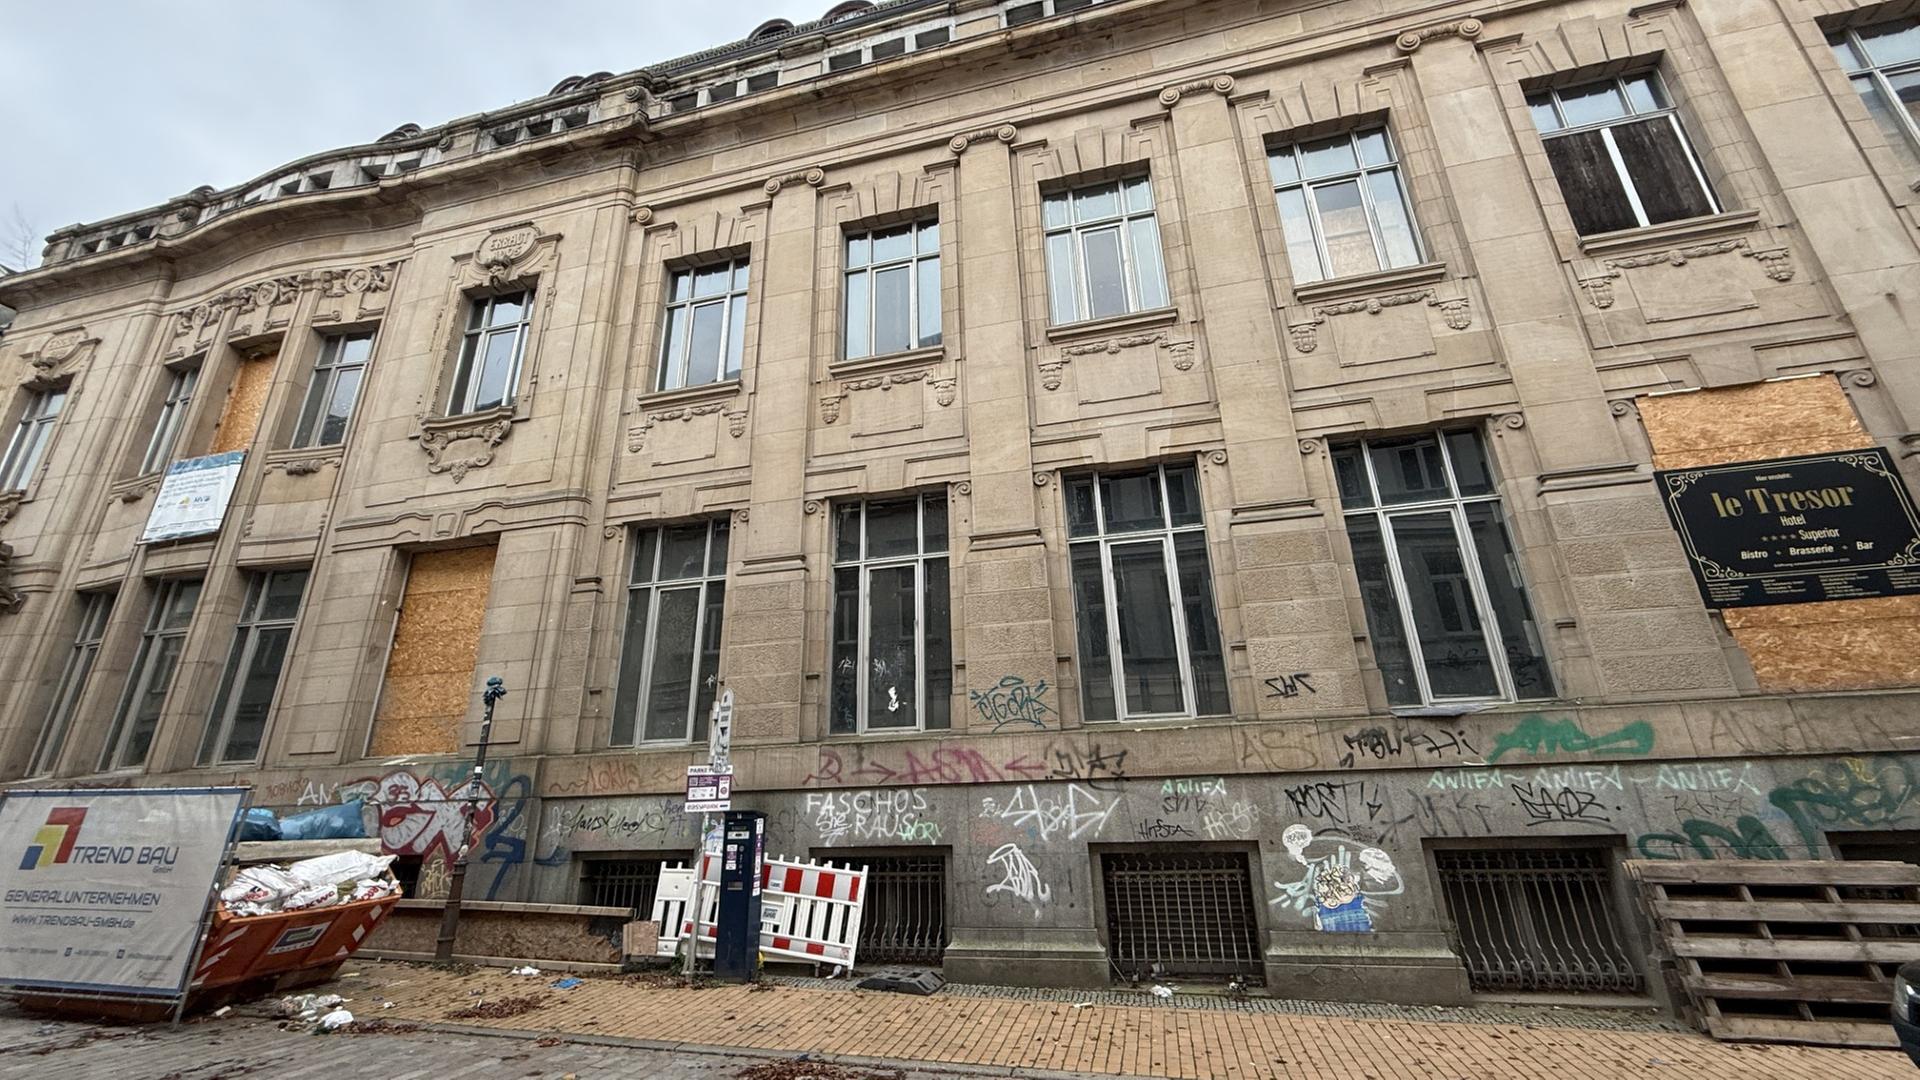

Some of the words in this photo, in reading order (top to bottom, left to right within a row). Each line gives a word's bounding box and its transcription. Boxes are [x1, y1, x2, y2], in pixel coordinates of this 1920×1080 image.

[1711, 492, 1744, 517] le
[1745, 486, 1854, 514] Tresor
[1780, 514, 1807, 527] Hotel
[1798, 527, 1840, 541] Superior
[1741, 551, 1768, 560] Bistro
[1789, 544, 1834, 556] Brasserie
[1856, 541, 1874, 550] Bar
[806, 787, 928, 817] FASCHOS
[855, 811, 915, 839] RAUS
[73, 846, 134, 864] TREND
[137, 846, 179, 865] BAU
[5, 889, 161, 906] GENERALUNTERNEHMEN
